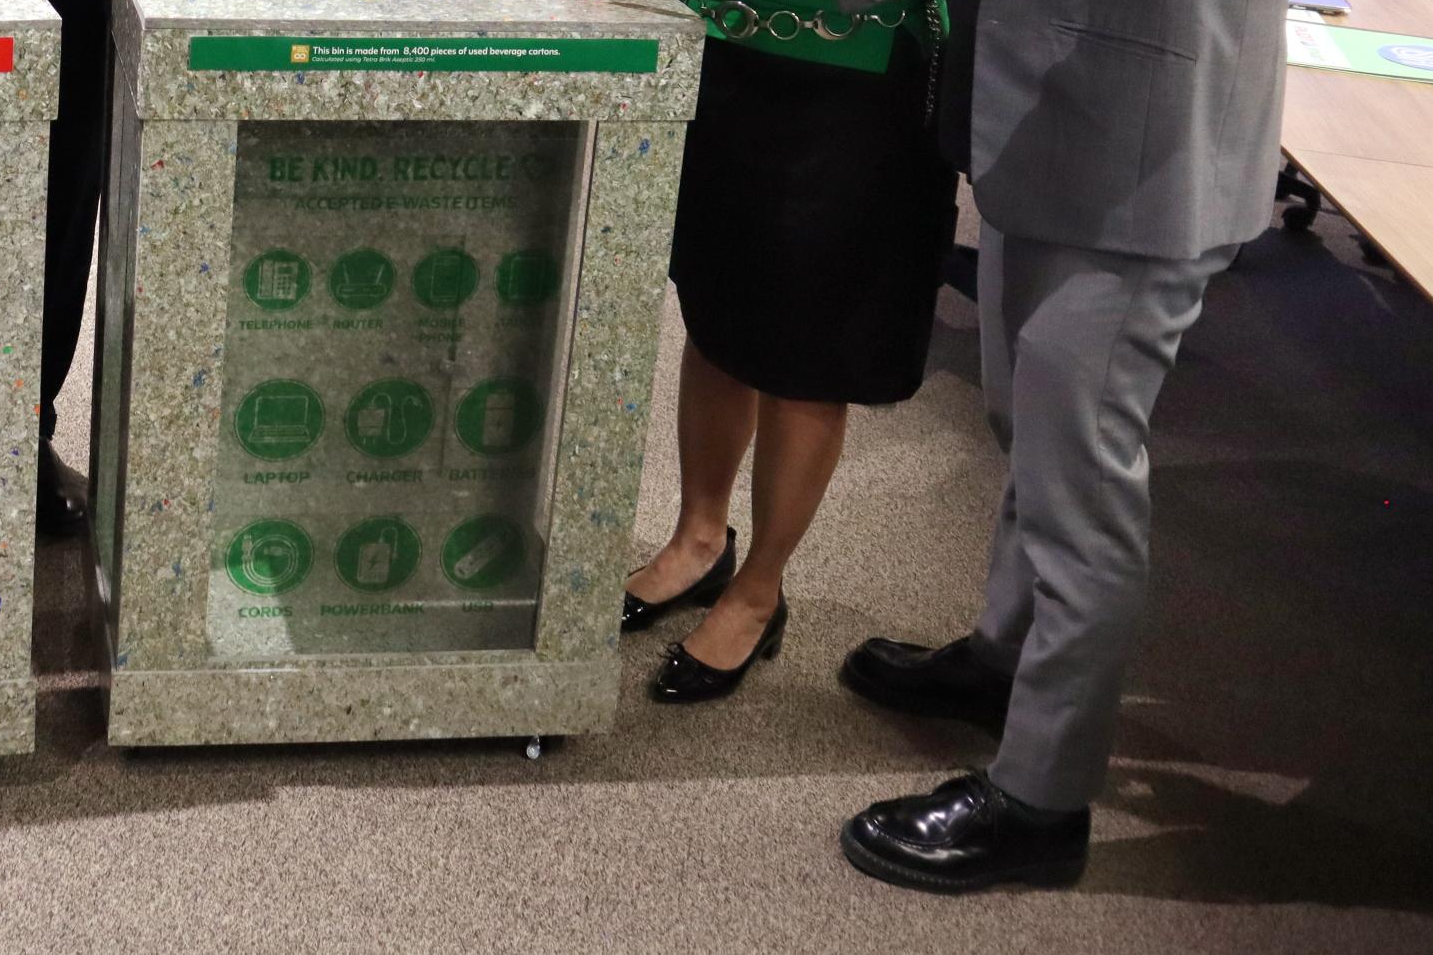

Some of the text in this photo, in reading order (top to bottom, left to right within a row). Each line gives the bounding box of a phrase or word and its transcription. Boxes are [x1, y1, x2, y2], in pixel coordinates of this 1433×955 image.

[312, 46, 330, 54] This
[332, 46, 345, 54] bin
[346, 46, 353, 54] is
[355, 46, 378, 55] made
[380, 46, 399, 55] from
[431, 47, 456, 56] pieces
[458, 47, 467, 55] of
[468, 47, 488, 55] used
[489, 47, 527, 56] beverage
[528, 48, 561, 56] cartons.
[269, 156, 305, 182] BE
[295, 196, 382, 211] ACCEPTED
[465, 196, 517, 210] ITEMS
[239, 319, 313, 331] TELEPHONE
[332, 318, 384, 330] ROUTER
[243, 471, 311, 484] LAPTOP
[345, 470, 423, 483] CHARGER
[238, 605, 294, 618] CORDS
[320, 603, 425, 617] POWERBANK
[462, 602, 495, 613] USB
